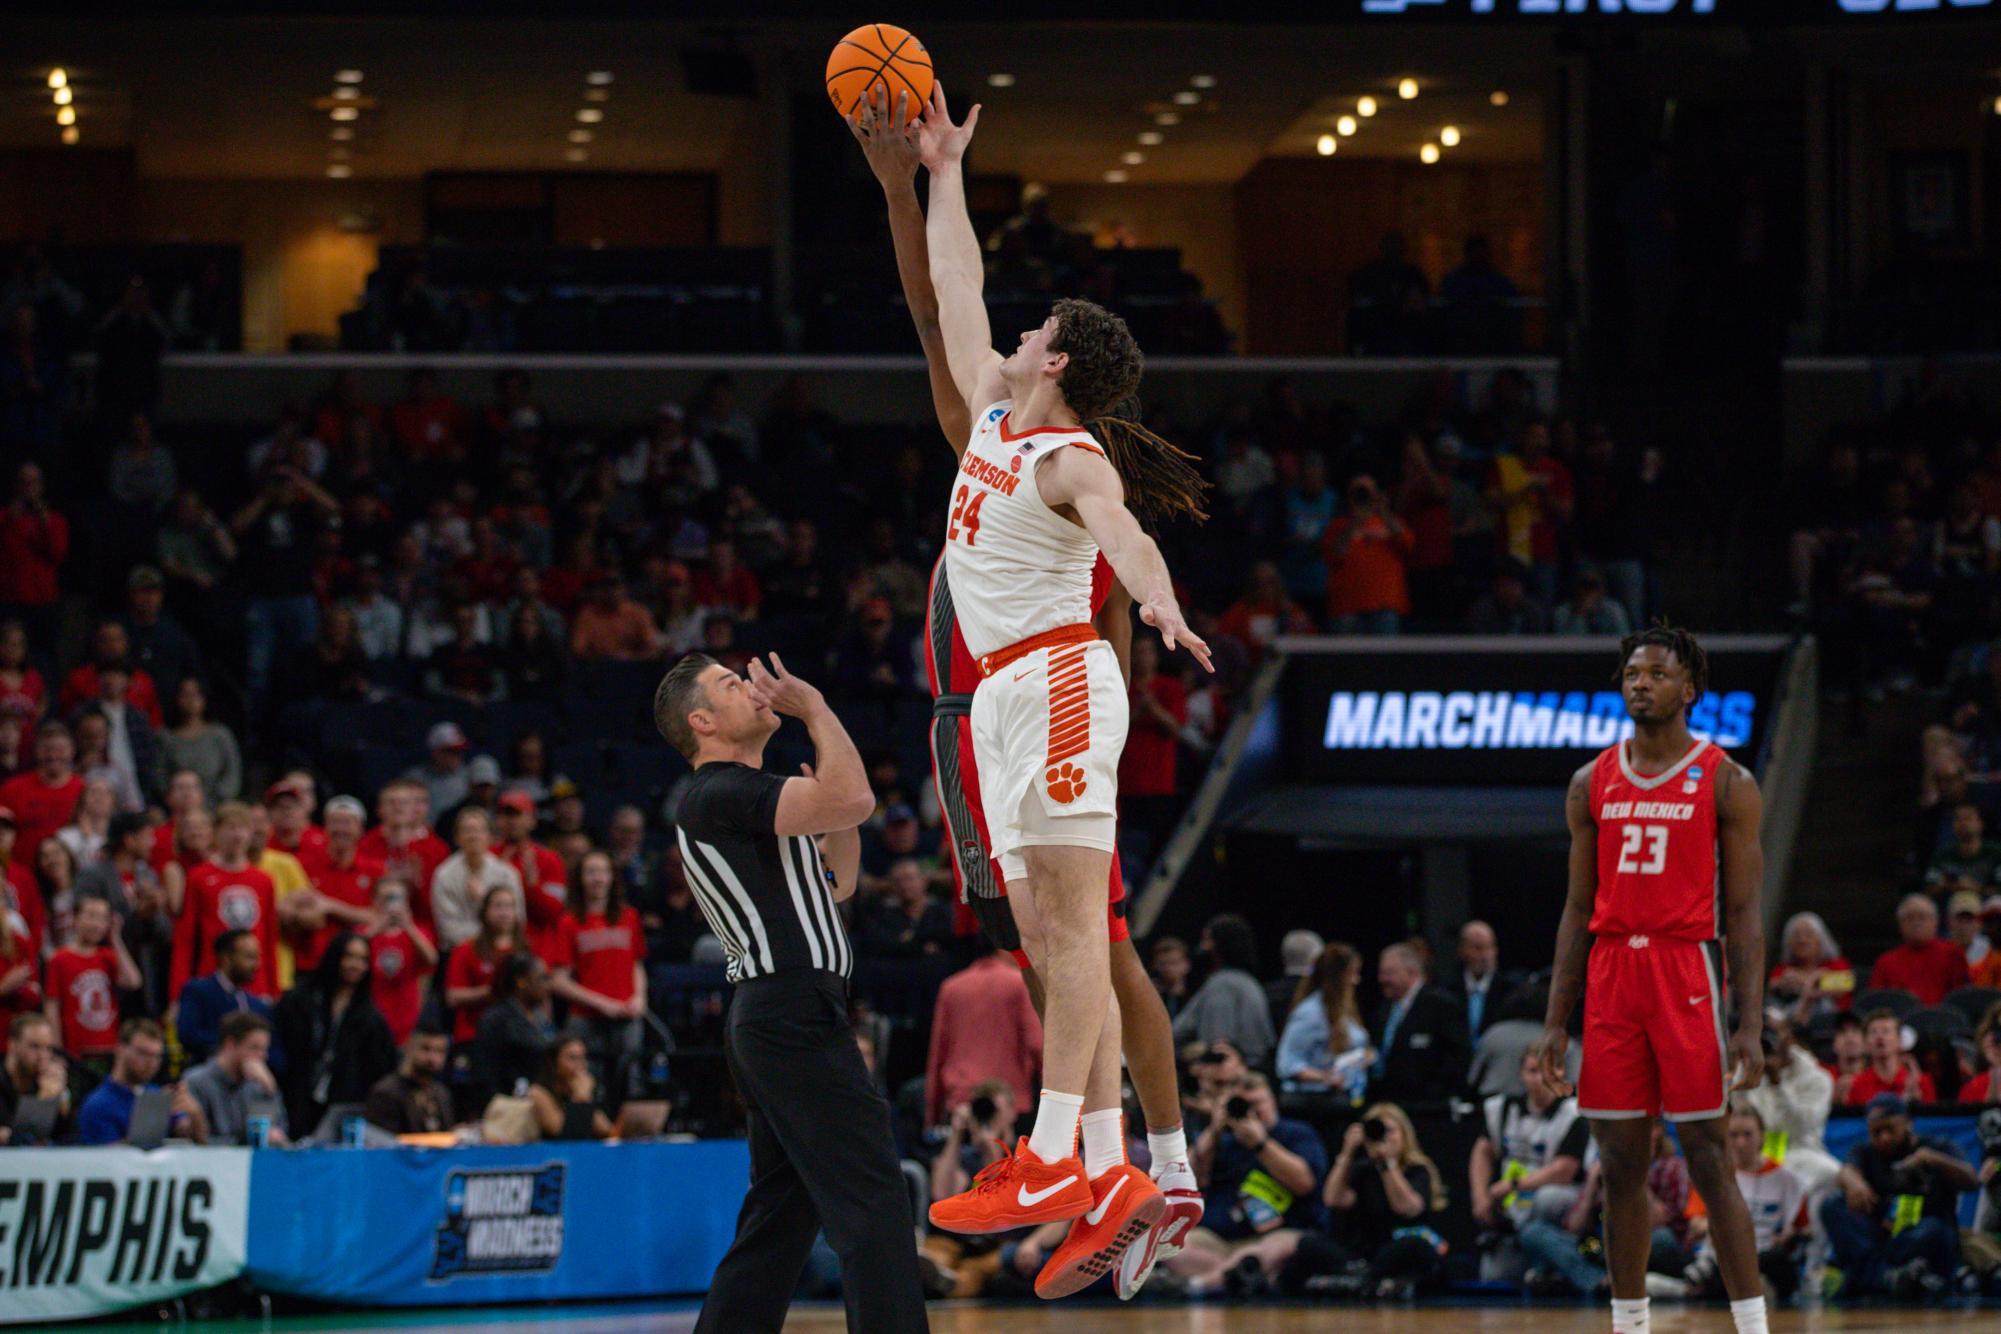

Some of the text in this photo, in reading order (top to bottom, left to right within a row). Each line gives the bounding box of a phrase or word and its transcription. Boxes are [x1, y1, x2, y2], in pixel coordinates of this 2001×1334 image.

[947, 484, 989, 546] 24
[1600, 801, 1695, 820] NEW MEXICO
[1617, 824, 1669, 875] 23
